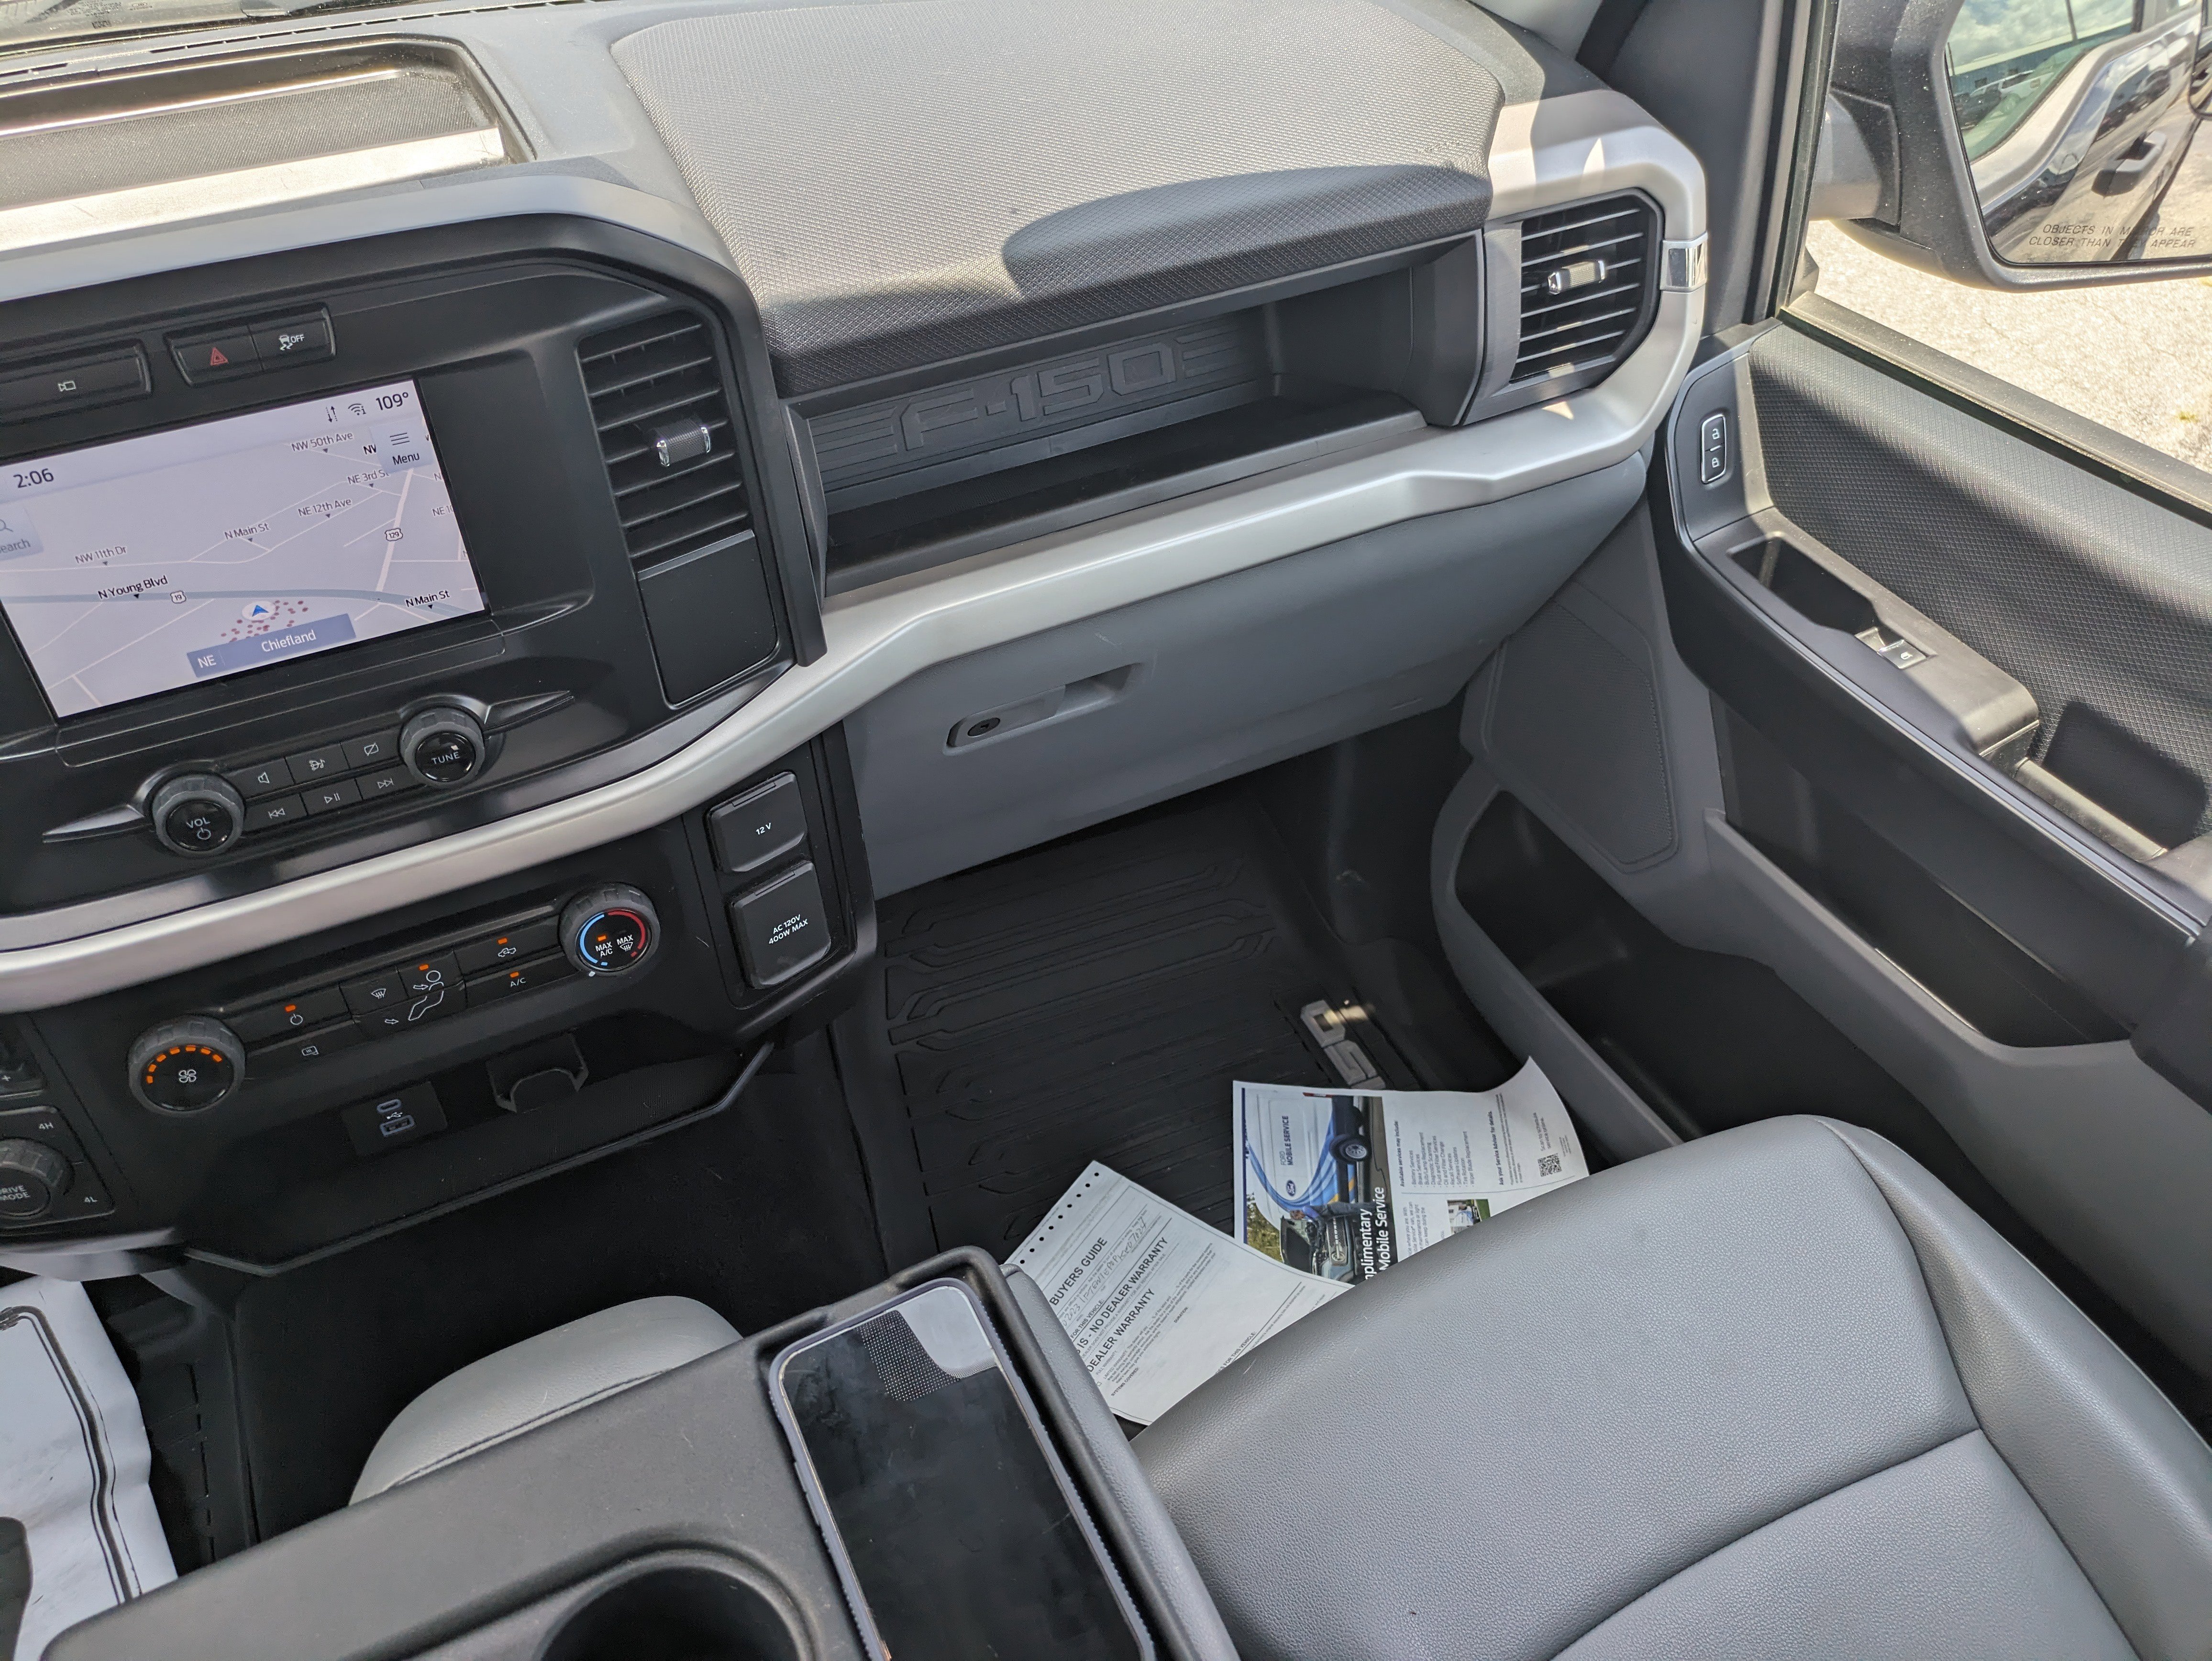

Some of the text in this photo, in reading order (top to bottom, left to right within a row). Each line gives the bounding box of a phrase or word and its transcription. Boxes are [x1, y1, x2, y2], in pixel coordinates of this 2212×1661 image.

[2043, 224, 2095, 234] OBJECTS
[2102, 227, 2113, 235] IN
[2169, 227, 2194, 236] ARE
[2029, 236, 2074, 246] CLOSER
[2081, 238, 2110, 247] THAN
[2151, 239, 2197, 248] APPEAR
[290, 334, 305, 343] OFF
[900, 343, 1175, 451] F-150
[291, 432, 354, 452] NW 50th Ave
[392, 452, 420, 465] Menu
[13, 468, 54, 488] 2:06
[347, 475, 361, 485] NE
[362, 470, 378, 482] 3rd
[298, 498, 352, 517] NE 12th Ave
[432, 506, 446, 517] NE
[224, 522, 270, 540] N Main St
[388, 531, 400, 539] 129
[0, 538, 31, 554] earch
[75, 545, 127, 564] NW 11th Dr
[98, 575, 168, 600] N Young Blvd
[406, 590, 450, 607] N Main St
[261, 629, 317, 654] Chiefland
[197, 654, 217, 669] NE
[431, 750, 461, 764] TUNE
[186, 816, 211, 829] VOL
[755, 826, 765, 835] 12
[768, 919, 808, 945] 400W MAX
[773, 914, 801, 934] AC 120V
[595, 941, 613, 952] MAX
[617, 934, 634, 945] MAX
[600, 948, 613, 959] A/C
[509, 977, 526, 987] A/C
[1282, 1116, 1293, 1165] MOBILE SERVICE
[1372, 1186, 1391, 1269] Mobile Service
[1048, 1265, 1085, 1306] BUYERS
[1079, 1236, 1108, 1268] GUIDE
[1076, 1336, 1089, 1349] IS
[1088, 1317, 1105, 1334] NO
[1100, 1283, 1133, 1319] DEALER
[1126, 1236, 1171, 1286] WARRANTY
[1070, 1327, 1081, 1339] FOR
[1077, 1317, 1089, 1329] THIS
[1085, 1297, 1105, 1319] VEHICLE:
[1084, 1334, 1118, 1373] DEALER
[1112, 1288, 1156, 1338] WARRANTY
